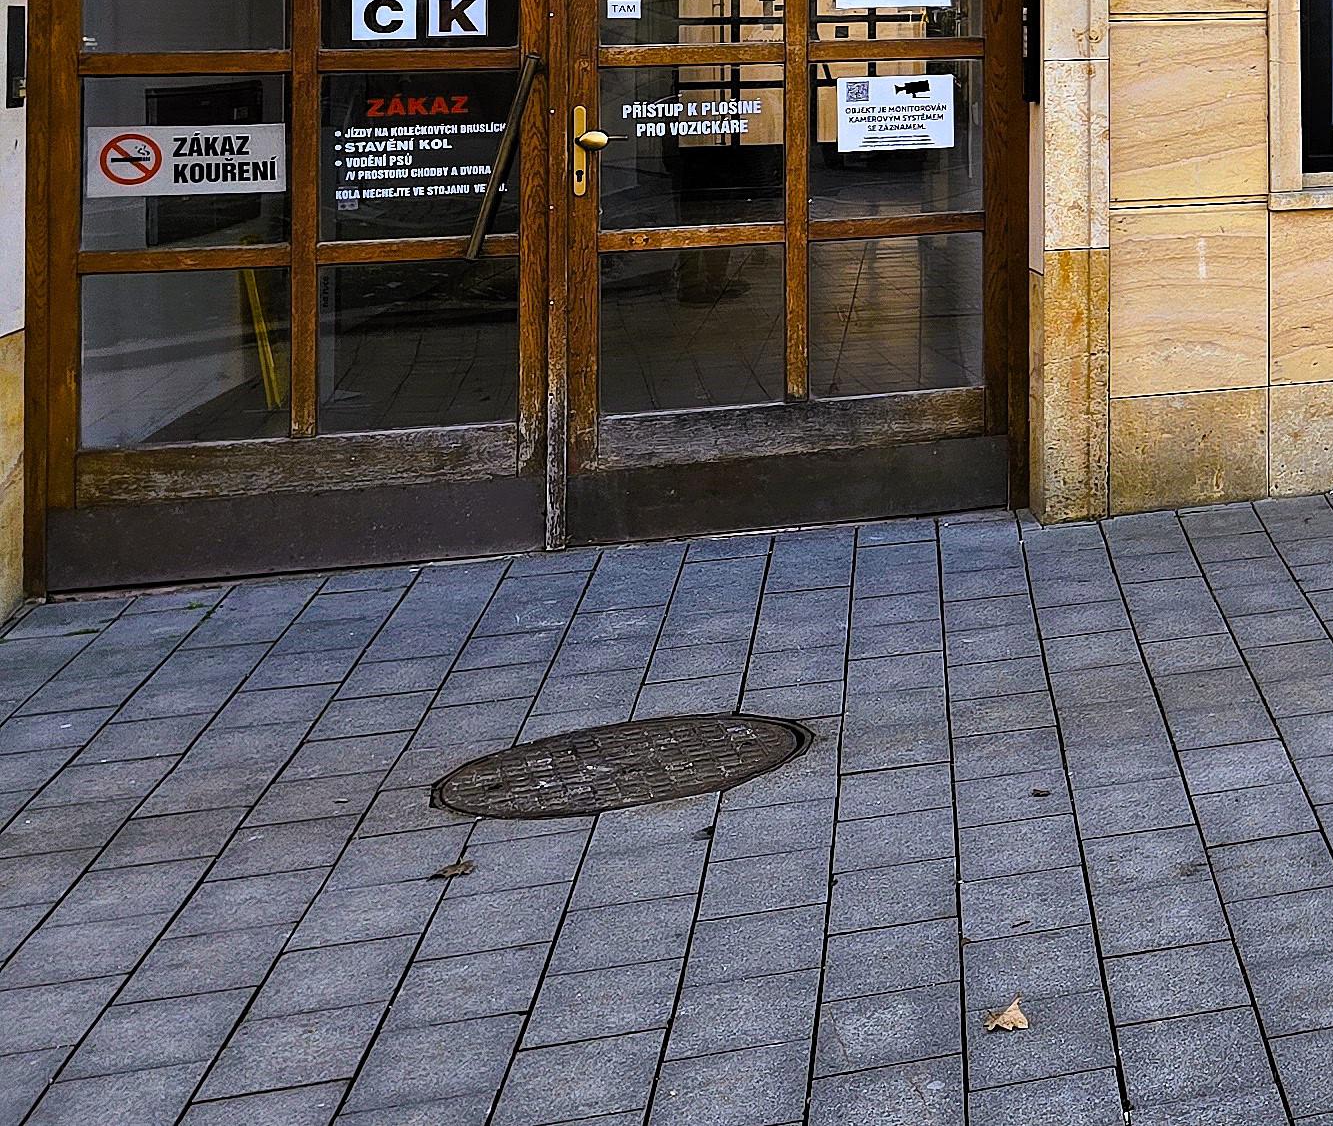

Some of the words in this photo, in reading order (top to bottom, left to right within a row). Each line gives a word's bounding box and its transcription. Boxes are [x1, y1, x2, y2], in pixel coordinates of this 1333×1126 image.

[367, 93, 468, 117] ZÁKAZ
[622, 102, 683, 118] PŘÍSTUP
[687, 103, 698, 116] K
[845, 106, 876, 114] OBJEKT
[888, 103, 946, 113] MONITOROVÁN
[849, 114, 900, 123] KAMEROVÝM
[902, 113, 944, 122] SYSTÉMEM
[345, 127, 372, 138] JÍZDY
[374, 127, 388, 137] NA
[391, 124, 458, 136] KOLEČKOVÝCH
[636, 123, 665, 136] PRO
[172, 132, 250, 158] ZÁKAZ
[345, 138, 414, 152] STAVĚNÍ
[419, 139, 452, 150] KOL
[345, 154, 387, 168] VODĚNÍ
[389, 153, 413, 166] PSŮ
[173, 156, 278, 184] KOUŘENÍ
[358, 169, 408, 180] PROSTORU
[410, 167, 448, 178] CHODBY
[451, 166, 458, 176] A
[460, 166, 491, 175] DVORA
[335, 189, 360, 200] KOLA
[362, 187, 410, 198] NECHEJTE
[413, 186, 425, 196] VE
[427, 184, 470, 196] STOJANU
[474, 184, 486, 192] VE
